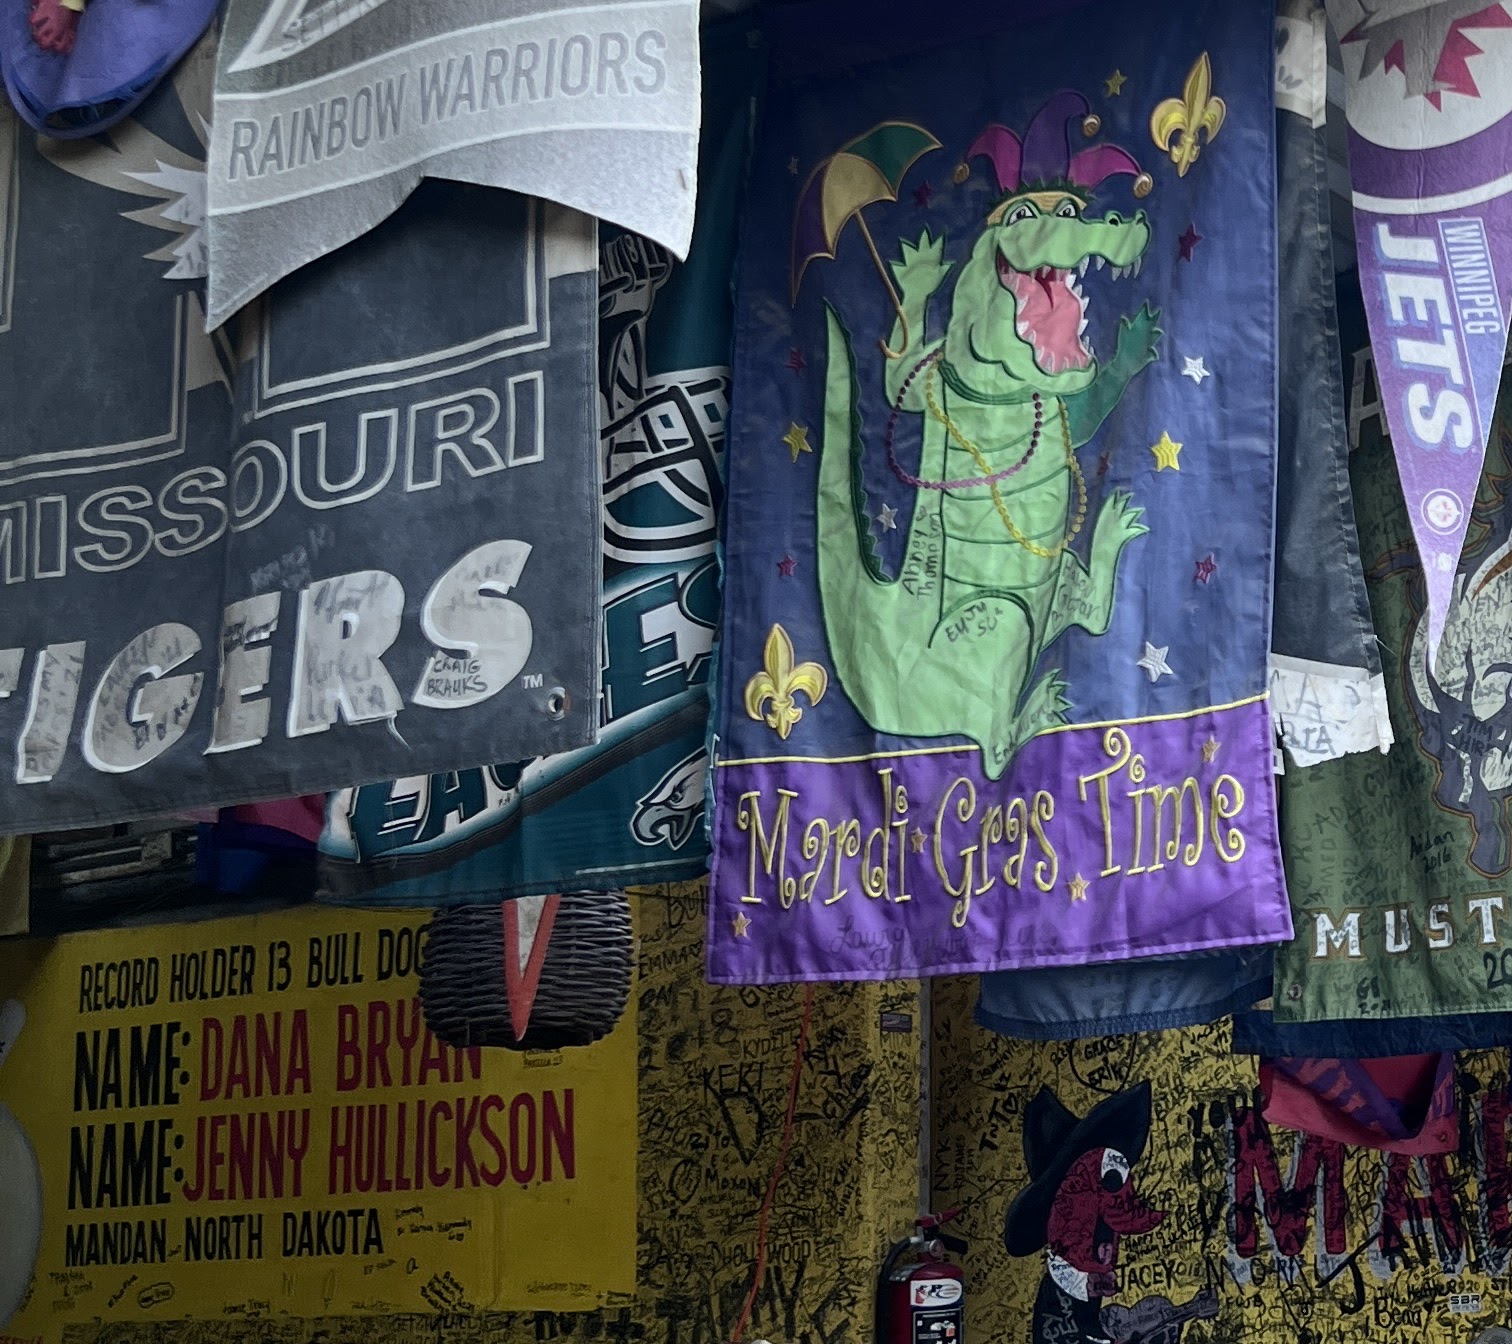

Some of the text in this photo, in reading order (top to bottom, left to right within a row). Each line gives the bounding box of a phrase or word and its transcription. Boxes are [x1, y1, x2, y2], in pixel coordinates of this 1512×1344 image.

[227, 29, 667, 182] RAINBOW WARRIORS
[1371, 222, 1475, 455] JETS
[1444, 222, 1502, 336] WINNIPEG
[736, 766, 912, 911] Mardi
[932, 775, 1060, 930] Gras
[1078, 726, 1247, 878] Time
[77, 955, 160, 1015] RECORD
[169, 943, 256, 1003] HOLDER
[267, 940, 293, 992] 13
[307, 931, 364, 989] BULL
[72, 1018, 192, 1112] NAME:
[200, 1007, 312, 1103] DANA
[67, 1087, 575, 1211] NAME: JENNY HULLICKSON
[64, 1217, 168, 1267] MANDAN
[184, 1212, 264, 1262] NORTH
[281, 1207, 385, 1258] DAKOTA
